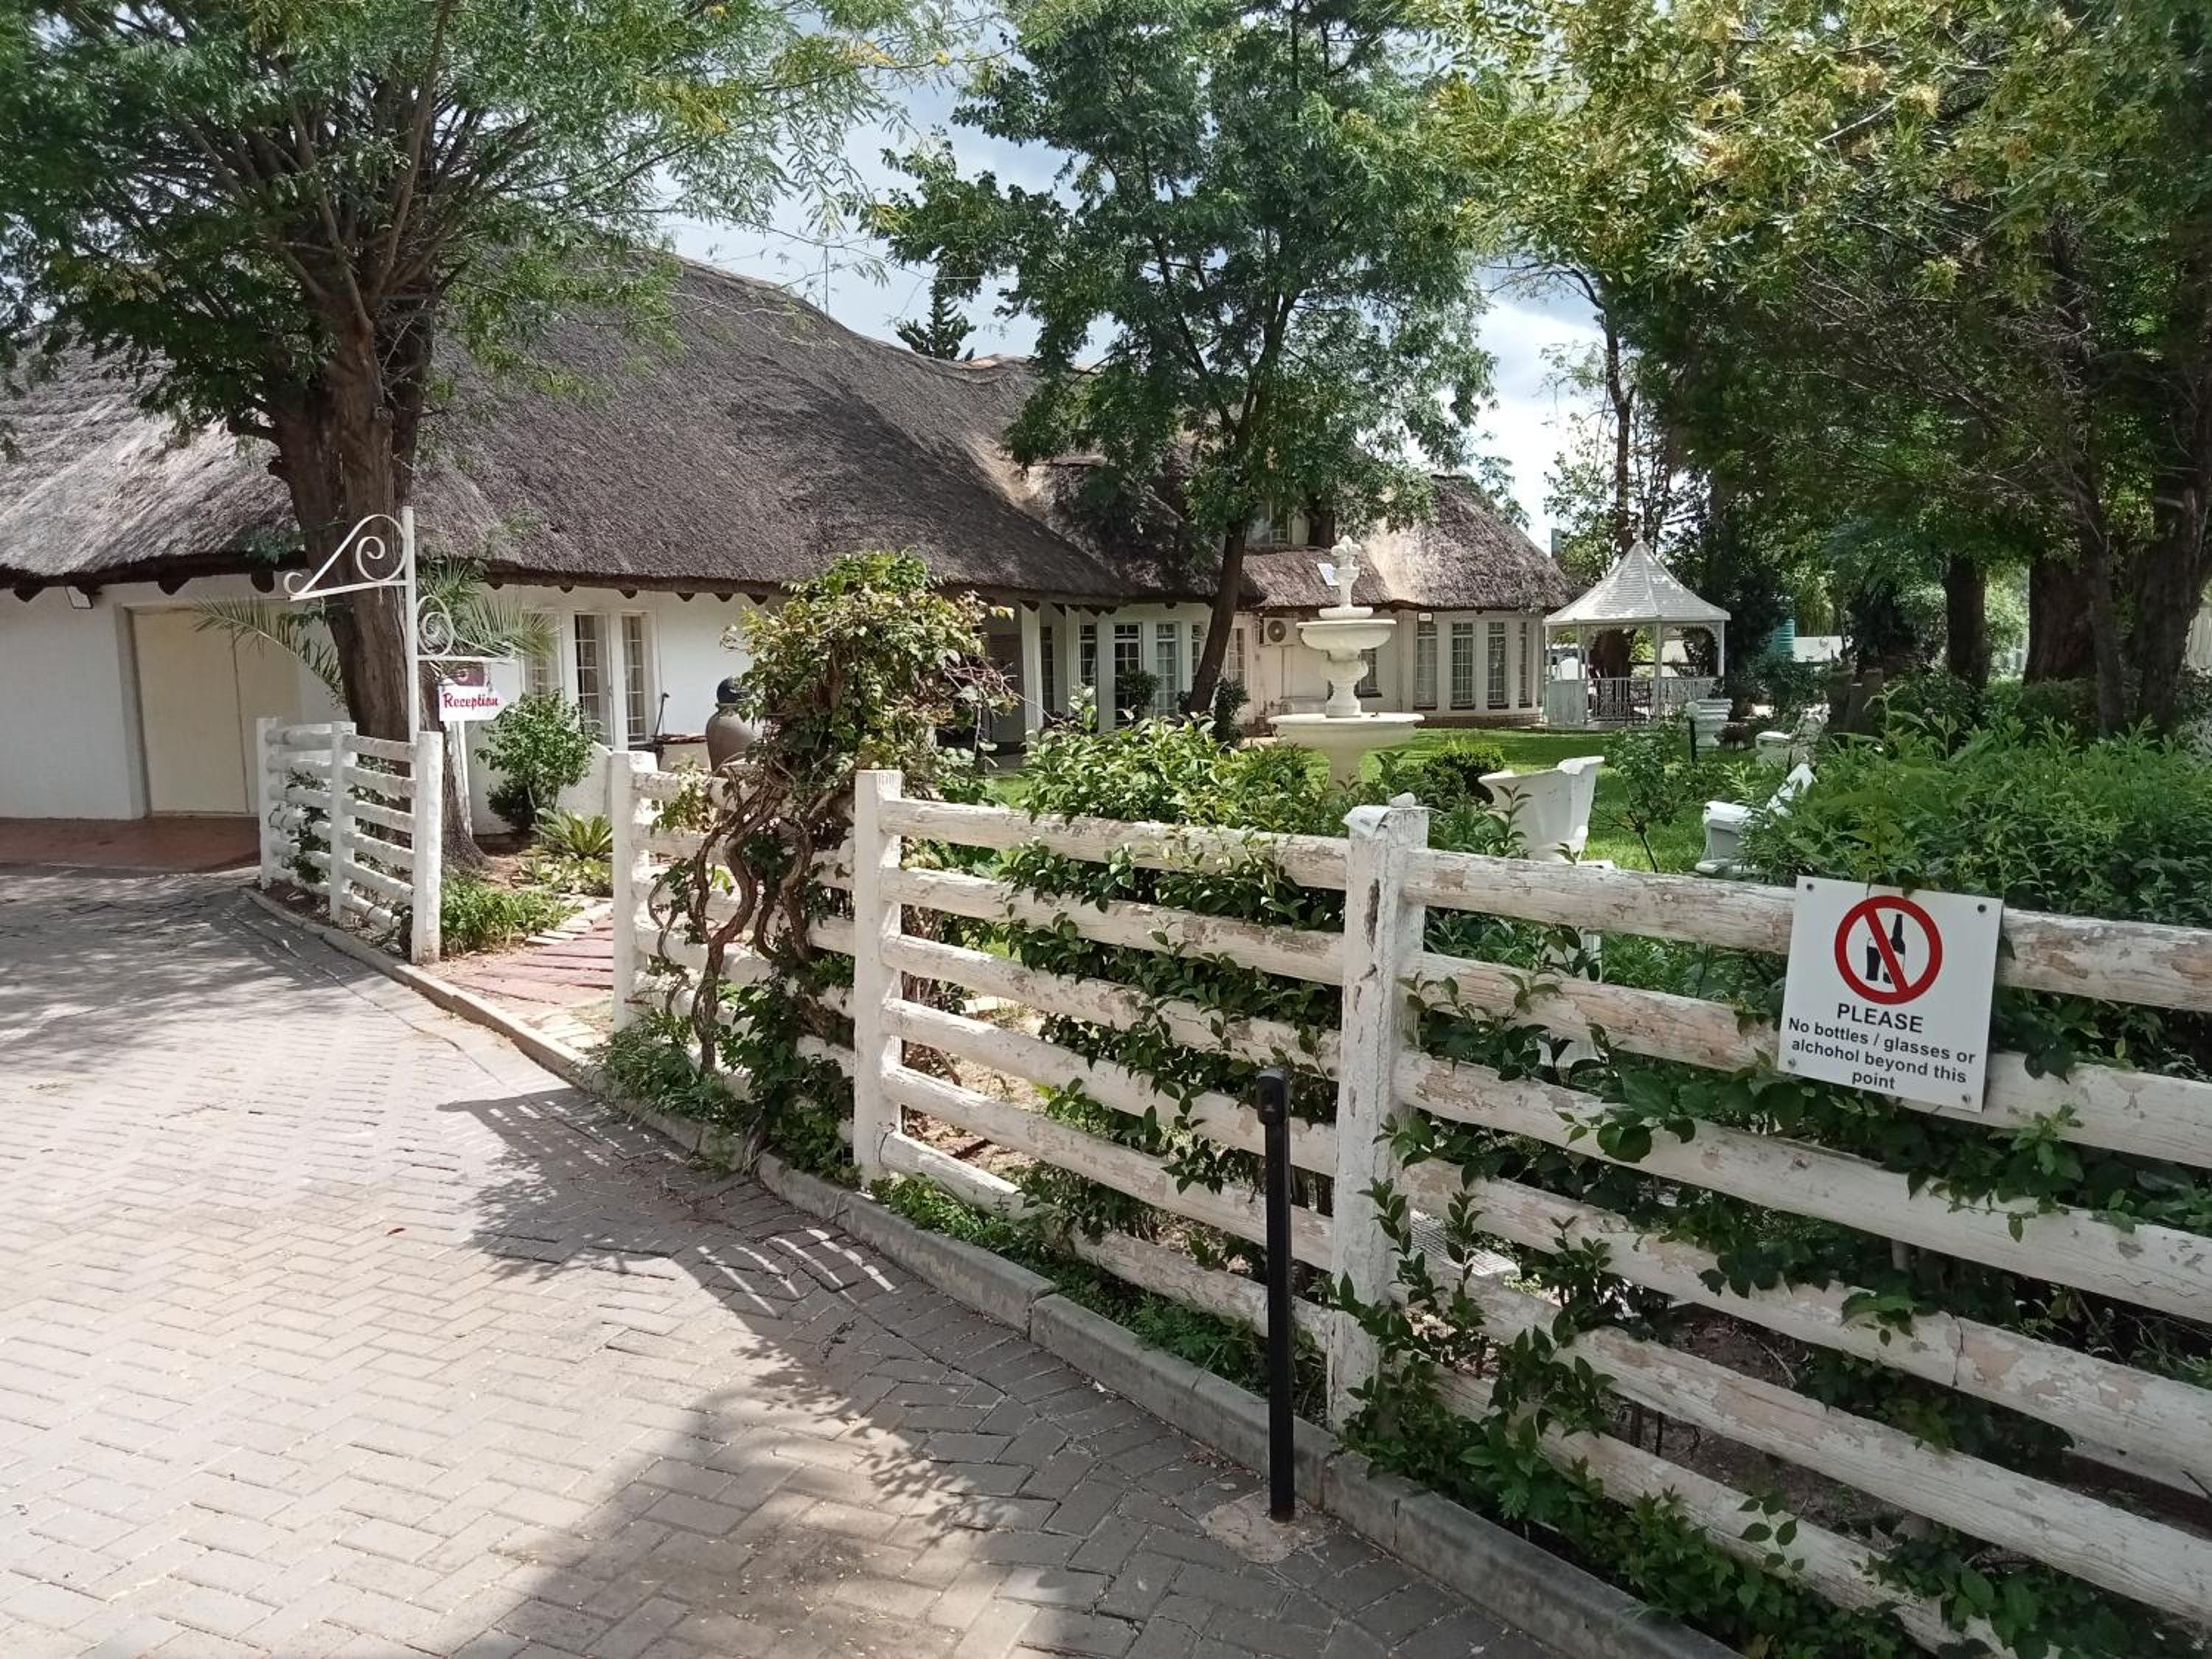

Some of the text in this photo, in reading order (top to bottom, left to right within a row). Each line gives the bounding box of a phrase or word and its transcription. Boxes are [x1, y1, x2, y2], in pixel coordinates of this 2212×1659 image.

[443, 692, 498, 711] Reception
[1837, 1003, 1924, 1033] PLEASE
[1788, 1017, 1809, 1033] No
[1815, 1022, 1868, 1046] bottles
[1884, 1037, 1950, 1060] glasses
[1956, 1051, 1976, 1065] or
[1792, 1039, 1967, 1083] alchohol beyond this
[1851, 1071, 1896, 1090] point
